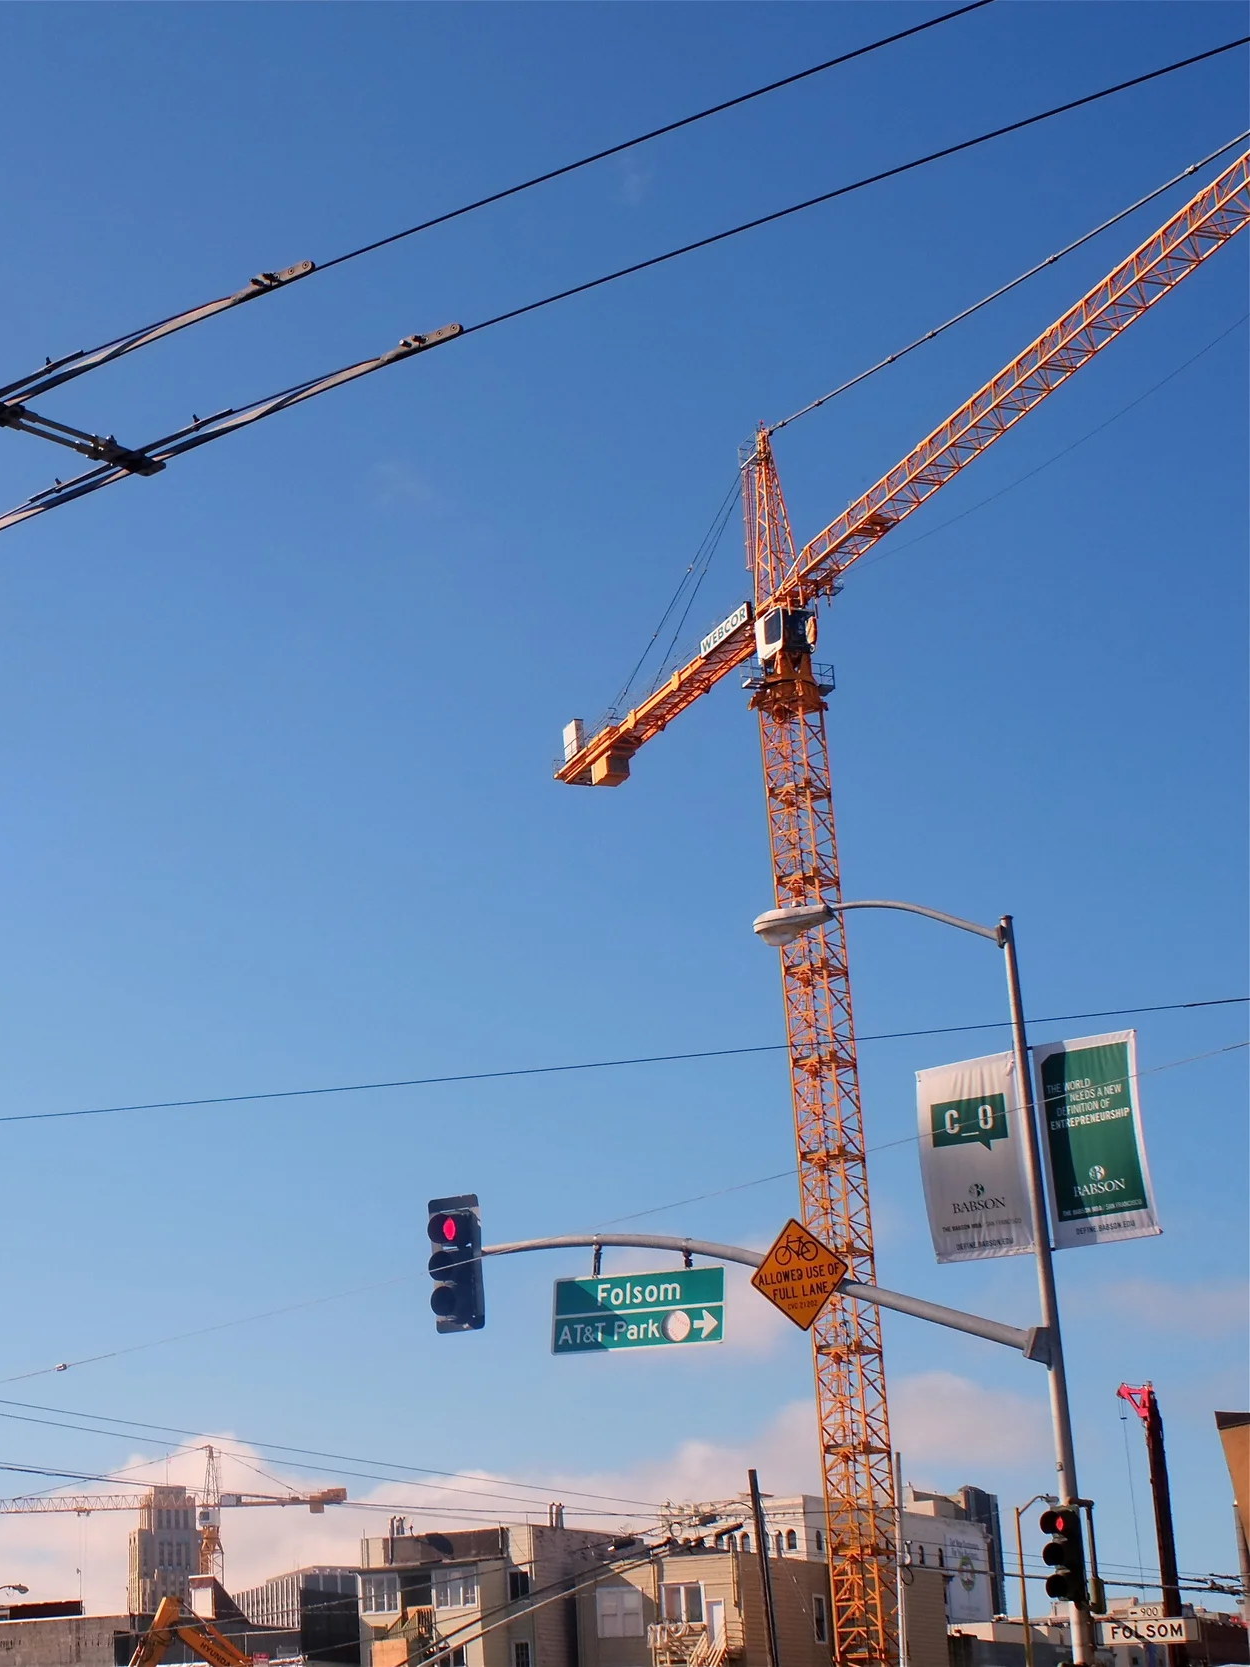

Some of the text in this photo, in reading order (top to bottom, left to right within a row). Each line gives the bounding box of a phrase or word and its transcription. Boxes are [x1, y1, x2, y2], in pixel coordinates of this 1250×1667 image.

[702, 607, 747, 653] WEBCOR
[1046, 1077, 1091, 1094] THE WORLD
[1070, 1084, 1122, 1102] NEEDS A NEW
[1056, 1097, 1110, 1116] DEFINITION OF
[1051, 1107, 1130, 1130] ENTREPRENEURSHIP
[1073, 1178, 1126, 1198] BABSON
[952, 1196, 1007, 1214] BABSON
[758, 1262, 840, 1286] ALLOWED USE OF
[597, 1282, 681, 1306] Folsom
[773, 1281, 829, 1300] FULL LANE
[558, 1319, 660, 1345] AT&T Park
[1140, 1607, 1158, 1617] 900
[1111, 1623, 1183, 1639] FOLSOM
